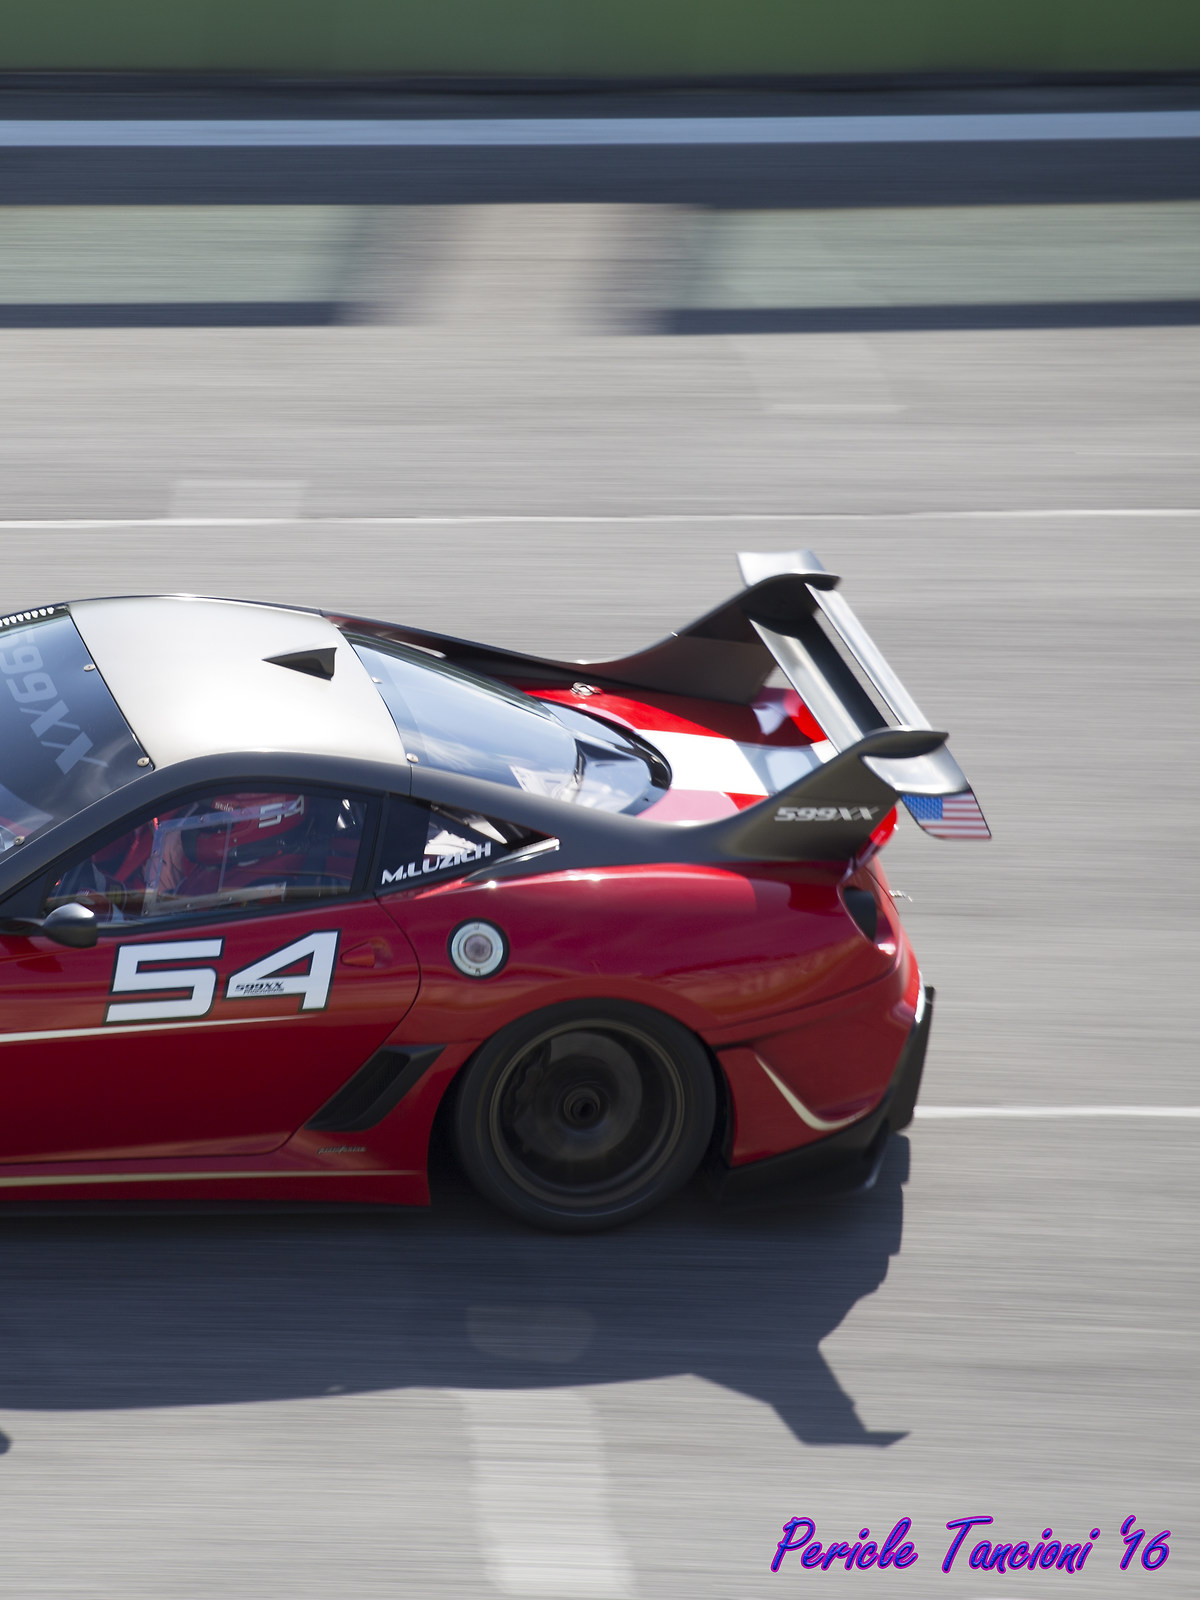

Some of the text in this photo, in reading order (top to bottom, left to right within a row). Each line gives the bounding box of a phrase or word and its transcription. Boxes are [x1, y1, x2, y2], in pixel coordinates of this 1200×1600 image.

[258, 794, 305, 829] 54
[774, 806, 880, 822] 599XX
[380, 841, 492, 885] M.LUZICH
[103, 928, 341, 1025] 54
